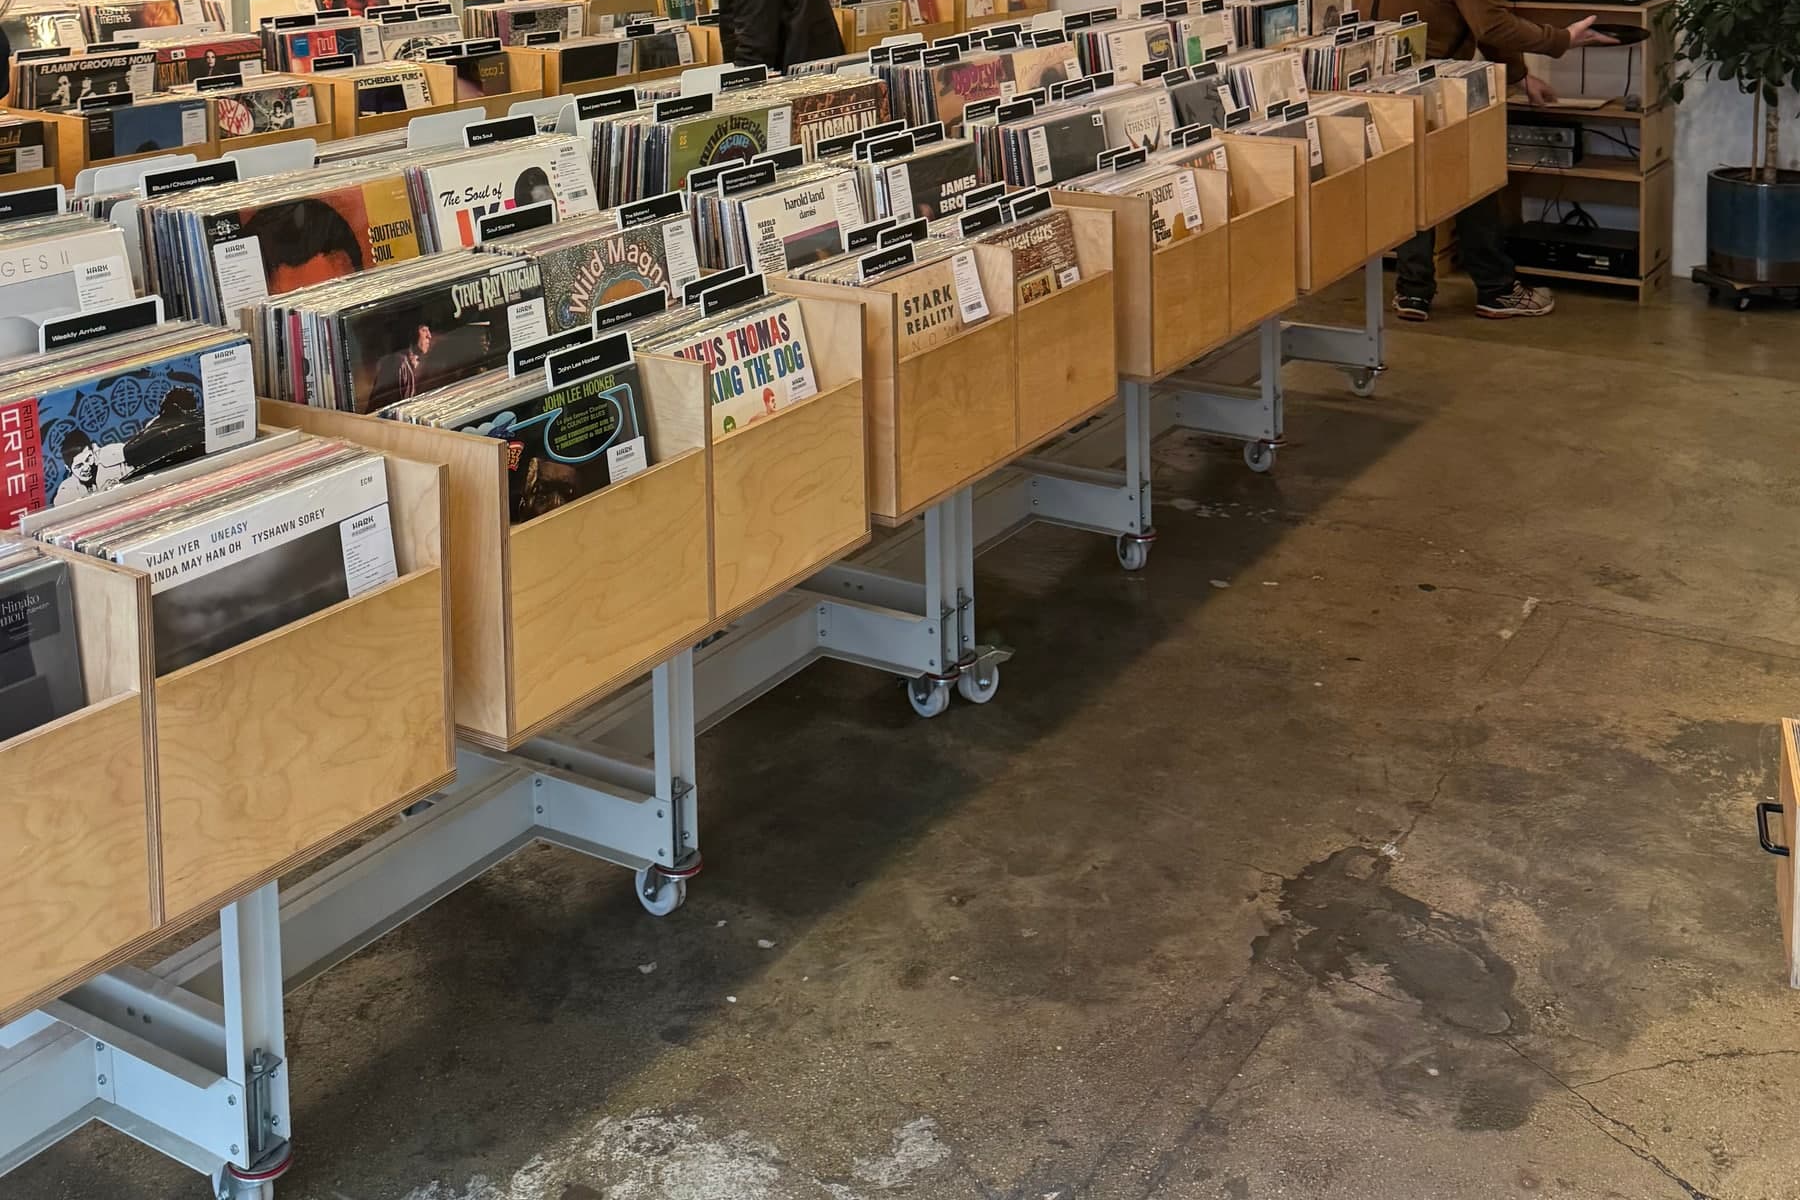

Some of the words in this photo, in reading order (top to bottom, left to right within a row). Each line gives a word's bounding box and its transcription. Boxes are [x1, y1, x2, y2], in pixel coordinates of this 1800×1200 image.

[80, 58, 127, 72] GROOVIES
[128, 54, 154, 65] NOW
[358, 74, 400, 87] SYCHEDELIC
[401, 72, 419, 82] FURS
[1128, 119, 1144, 134] THIS
[718, 133, 750, 154] score
[172, 179, 197, 188] Chicago
[197, 175, 214, 184] blues
[939, 174, 977, 198] JAMES
[440, 191, 461, 207] The
[463, 188, 490, 203] Soul
[491, 182, 503, 198] of
[783, 194, 808, 211] harold
[808, 187, 825, 203] land
[939, 193, 964, 214] BRO
[369, 219, 413, 243] SOUTHERN
[485, 226, 498, 234] Soul
[498, 222, 515, 232] Sisters
[757, 218, 776, 229] HAROLD
[761, 226, 774, 235] LAND
[225, 243, 247, 254] HARK
[372, 243, 395, 263] SOUL
[86, 263, 109, 275] HARK
[568, 249, 604, 314] Wild
[607, 237, 671, 300] Magno
[451, 278, 483, 319] STEVIE
[481, 275, 500, 307] RAY
[499, 263, 542, 304] VAUGHAN
[903, 284, 952, 318] STARK
[906, 304, 955, 336] REALITY
[51, 331, 78, 342] Weekly
[78, 324, 107, 336] Arrivals
[726, 312, 790, 362] THOMAS
[215, 349, 235, 360] HARK
[519, 356, 534, 367] Blues
[557, 364, 571, 375] John
[571, 361, 581, 370] Lee
[581, 354, 601, 366] Hooker
[743, 352, 775, 390] THE
[773, 340, 805, 379] DOG
[543, 393, 566, 413] JOHN
[566, 388, 583, 404] LEE
[582, 374, 616, 398] HOOKER
[22, 404, 34, 440] RINO
[26, 446, 37, 468] DE
[360, 475, 374, 487] ECM
[352, 514, 375, 530] HARK
[146, 547, 175, 568] VIJAY
[177, 539, 200, 558] IYER
[210, 520, 249, 544] UNEASY
[181, 557, 203, 573] MAY
[205, 547, 227, 564] HAN
[228, 540, 242, 555] OH
[251, 520, 296, 545] TYSHAWN
[297, 507, 326, 528] SOREY
[1, 593, 40, 616] Hinako
